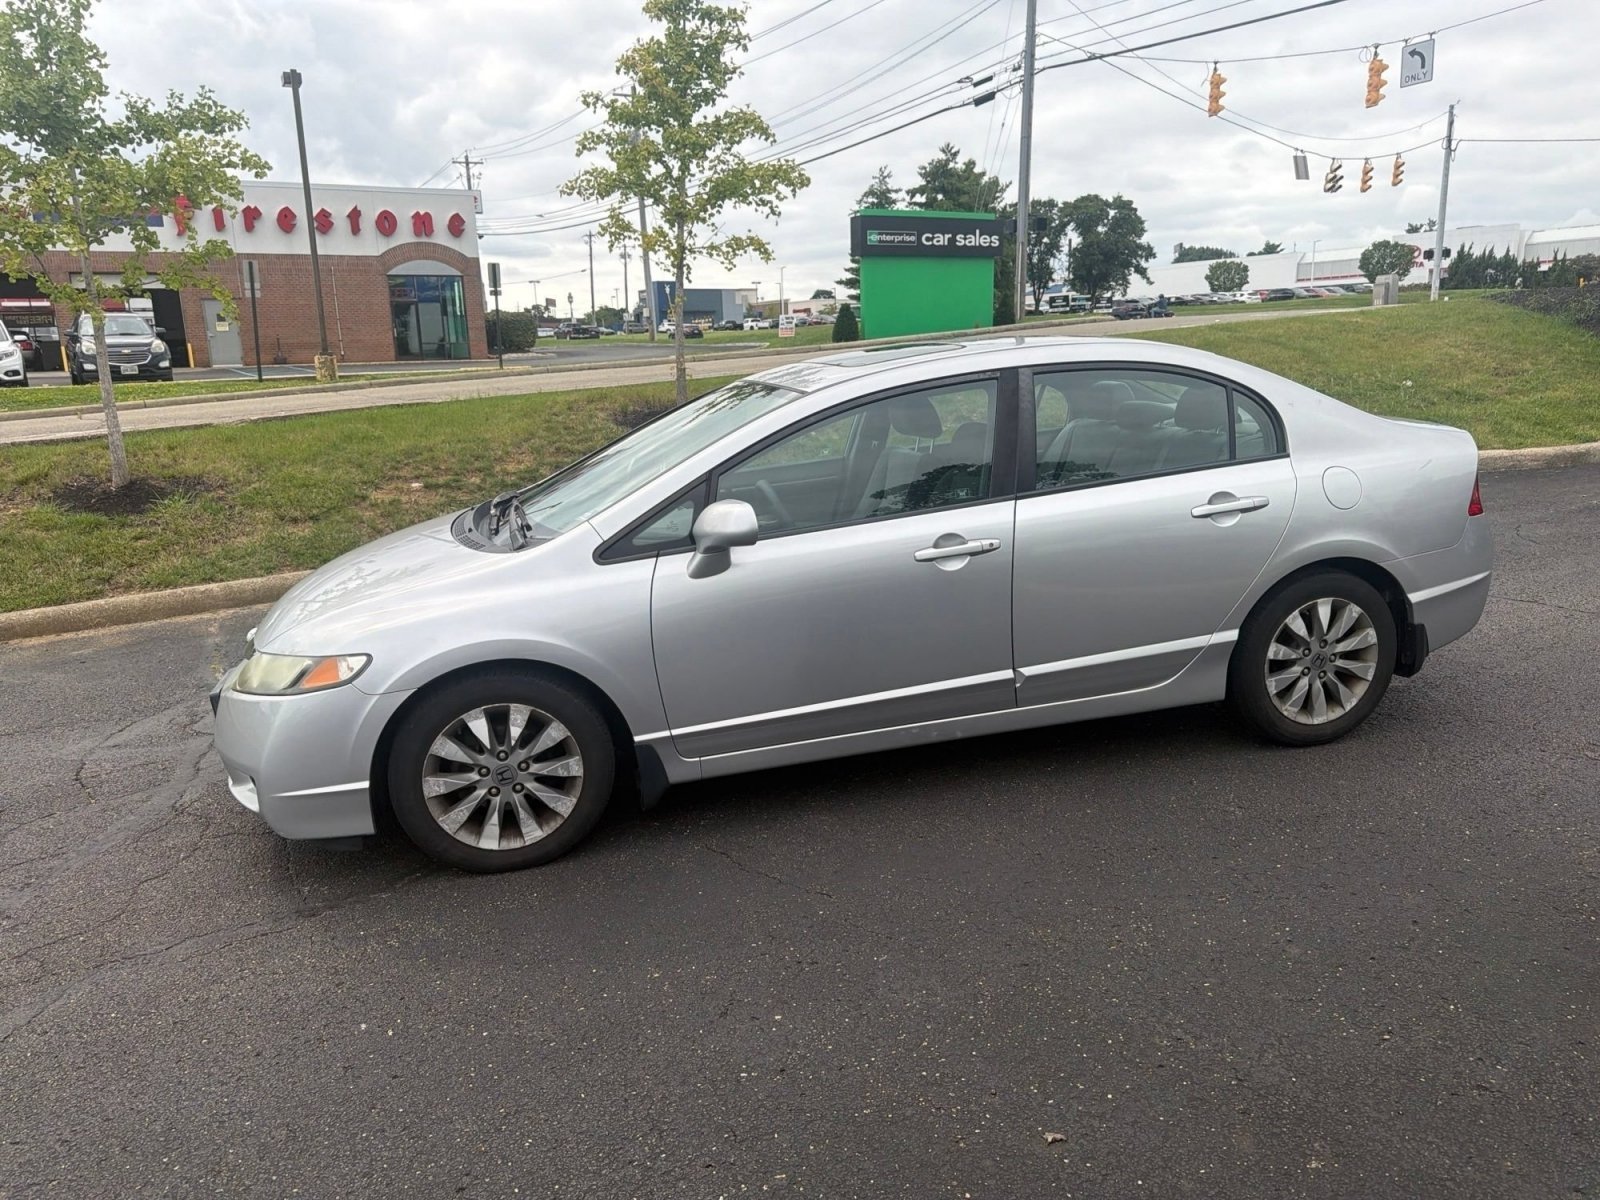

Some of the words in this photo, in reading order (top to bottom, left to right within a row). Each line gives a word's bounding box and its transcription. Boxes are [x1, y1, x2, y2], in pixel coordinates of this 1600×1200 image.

[1404, 71, 1428, 84] ONLY
[867, 232, 916, 243] enterprise
[921, 232, 952, 246] car
[955, 229, 1000, 247] sales
